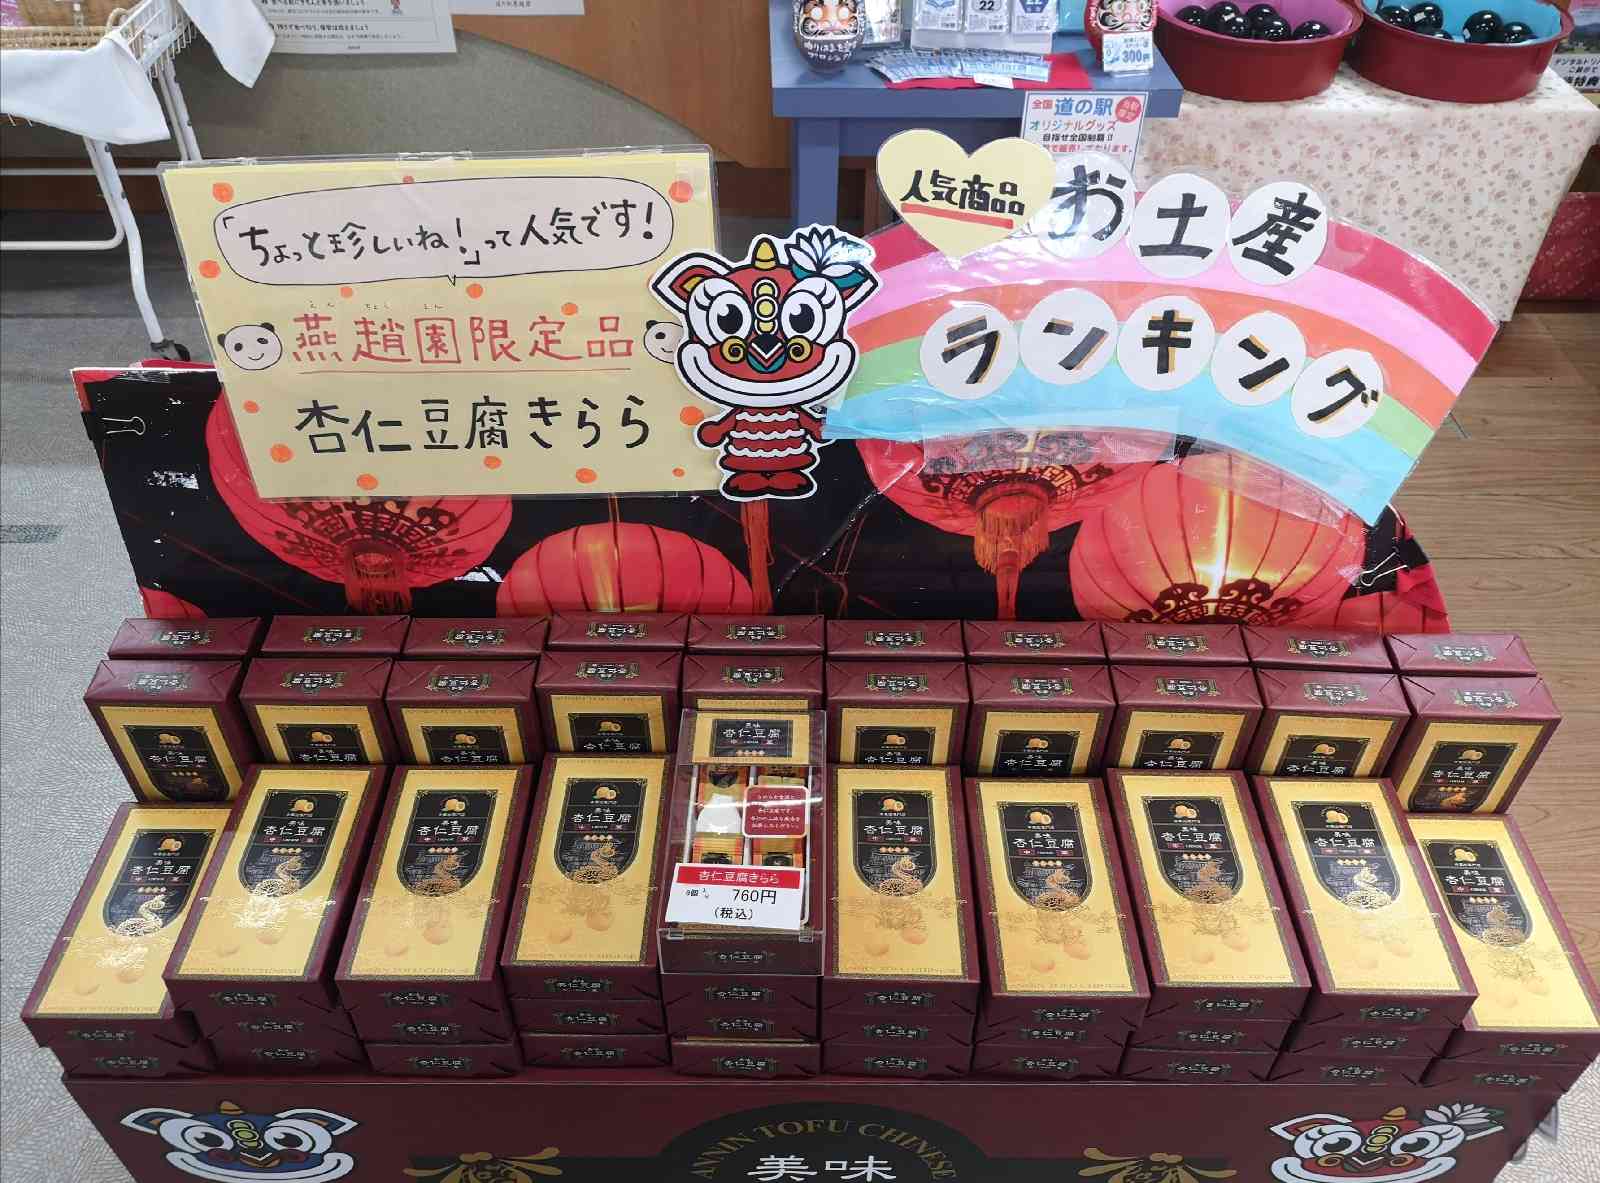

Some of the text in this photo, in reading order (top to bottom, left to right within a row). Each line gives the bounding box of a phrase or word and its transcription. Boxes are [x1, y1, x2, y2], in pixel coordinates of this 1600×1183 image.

[1054, 97, 1113, 115] 道の駅
[1030, 120, 1116, 131] オリジナルグッズ
[900, 168, 1025, 216] 人気商品
[1048, 164, 1321, 277] お土産
[291, 313, 634, 363] 燕趙園限定品
[941, 310, 1379, 424] ランキング
[295, 396, 650, 454] 杏仁豆腐きらら
[723, 729, 780, 738] 杏仁豆腐
[572, 812, 631, 823] 杏仁豆腐
[263, 826, 326, 836] 杏仁豆腐
[417, 825, 479, 837] 杏仁豆腐
[863, 824, 924, 836] 杏仁豆腐
[1014, 838, 1074, 849] 杏仁豆腐
[1161, 832, 1223, 843] 杏仁豆腐
[1314, 837, 1376, 849] 杏仁豆腐
[129, 865, 192, 876] 杏仁豆腐
[699, 871, 780, 885] 杏仁豆腐きらら
[1446, 876, 1504, 886] 杏仁豆腐
[733, 889, 776, 904] 760円
[715, 908, 753, 920] （税込）
[753, 1119, 849, 1137] TOFU
[858, 1121, 956, 1180] CHINESE
[747, 1155, 896, 1181] 美味
